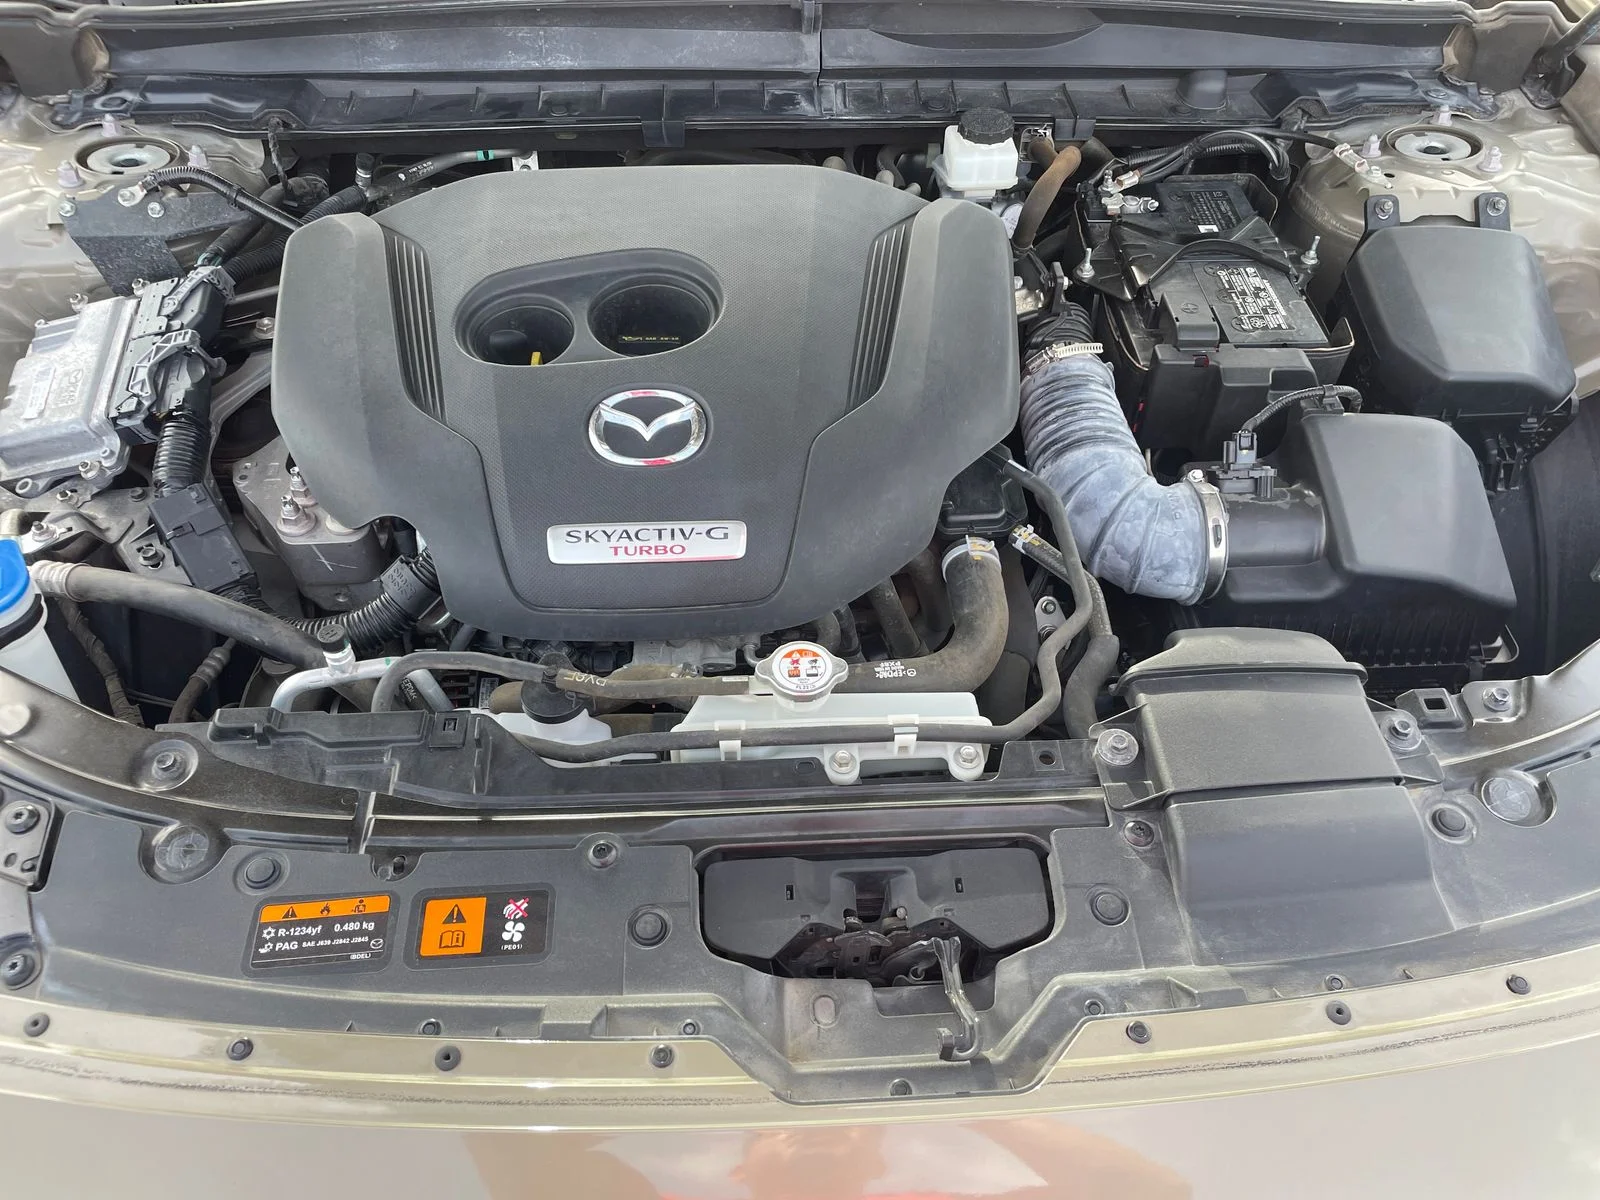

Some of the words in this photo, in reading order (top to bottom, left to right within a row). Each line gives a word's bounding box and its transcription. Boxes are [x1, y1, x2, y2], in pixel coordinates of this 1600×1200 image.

[565, 526, 729, 544] SKYACTIV-G
[609, 544, 686, 557] TURBO
[277, 925, 322, 937] R-1234yf
[334, 921, 360, 932] 0.480
[362, 920, 375, 931] kg
[275, 941, 299, 952] PAG
[302, 940, 316, 948] SAE
